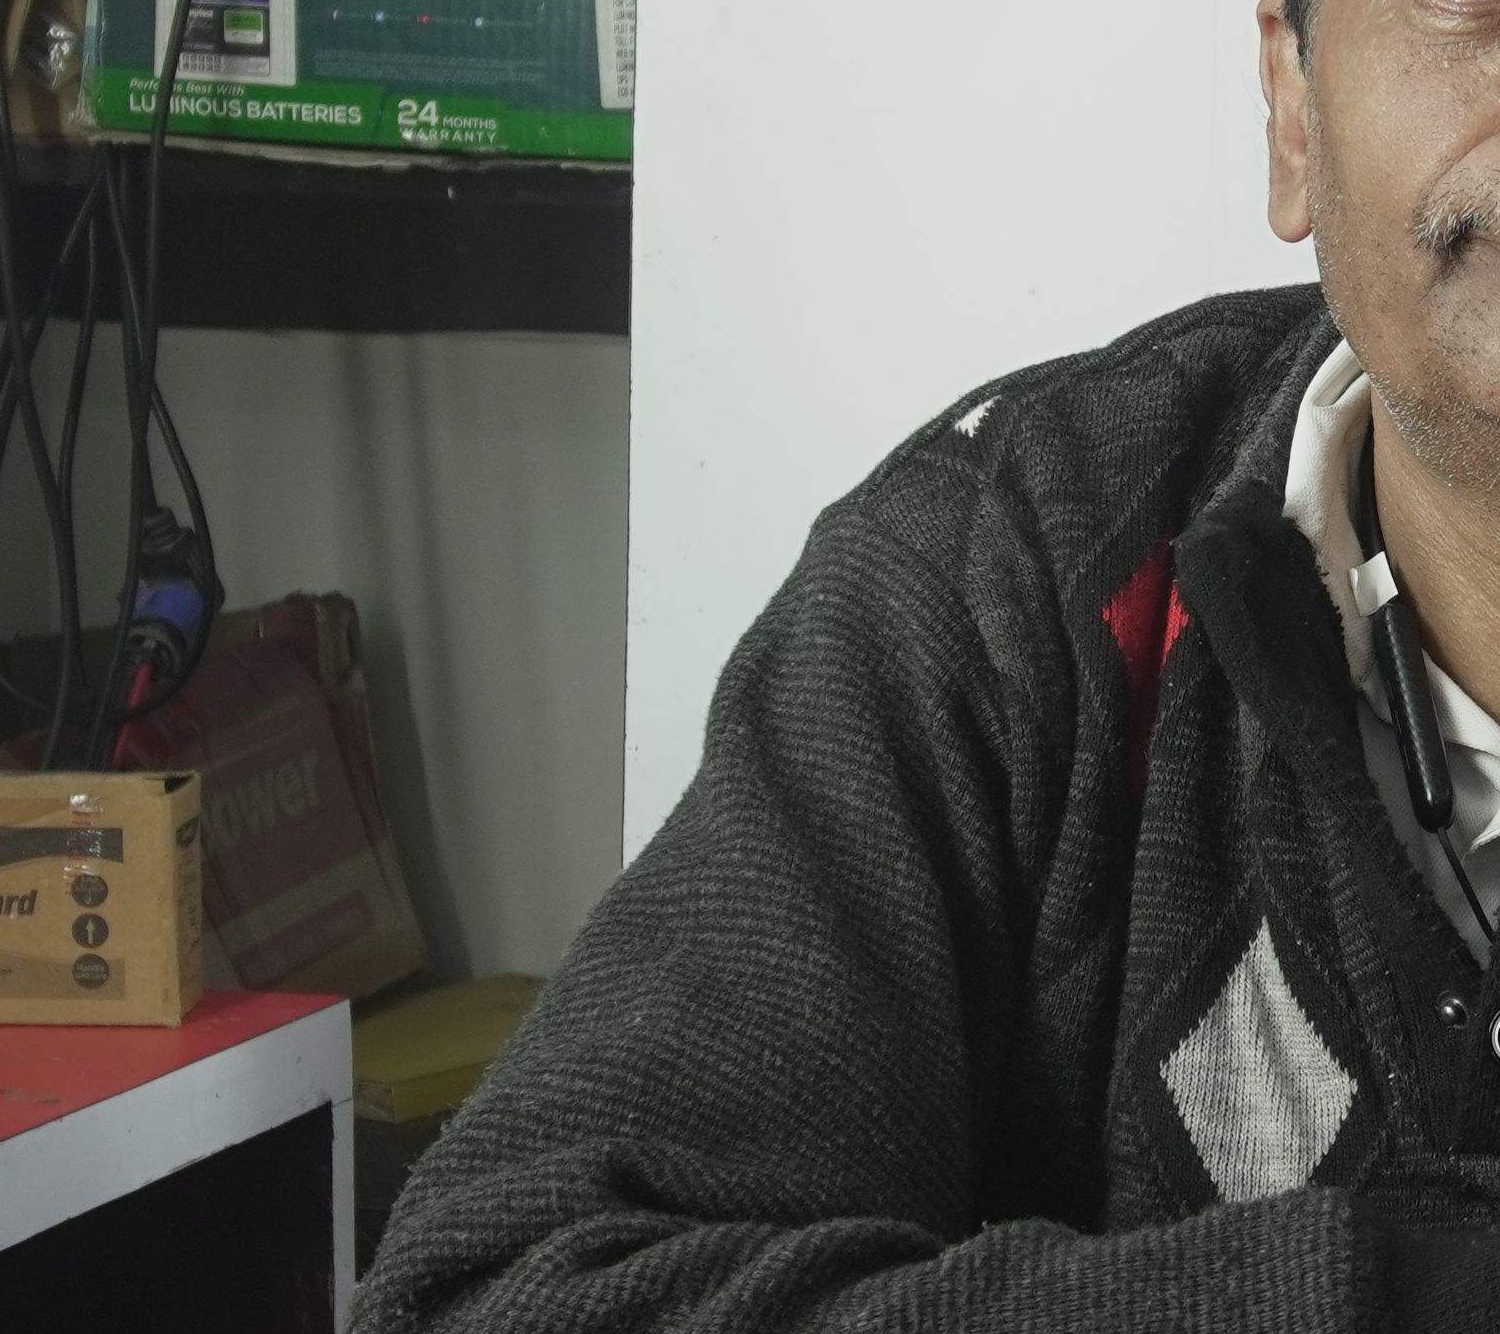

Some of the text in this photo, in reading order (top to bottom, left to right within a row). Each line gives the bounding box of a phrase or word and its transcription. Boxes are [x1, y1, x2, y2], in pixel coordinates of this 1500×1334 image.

[246, 101, 362, 125] BATTERIES
[397, 98, 498, 131] 24 MONTHS
